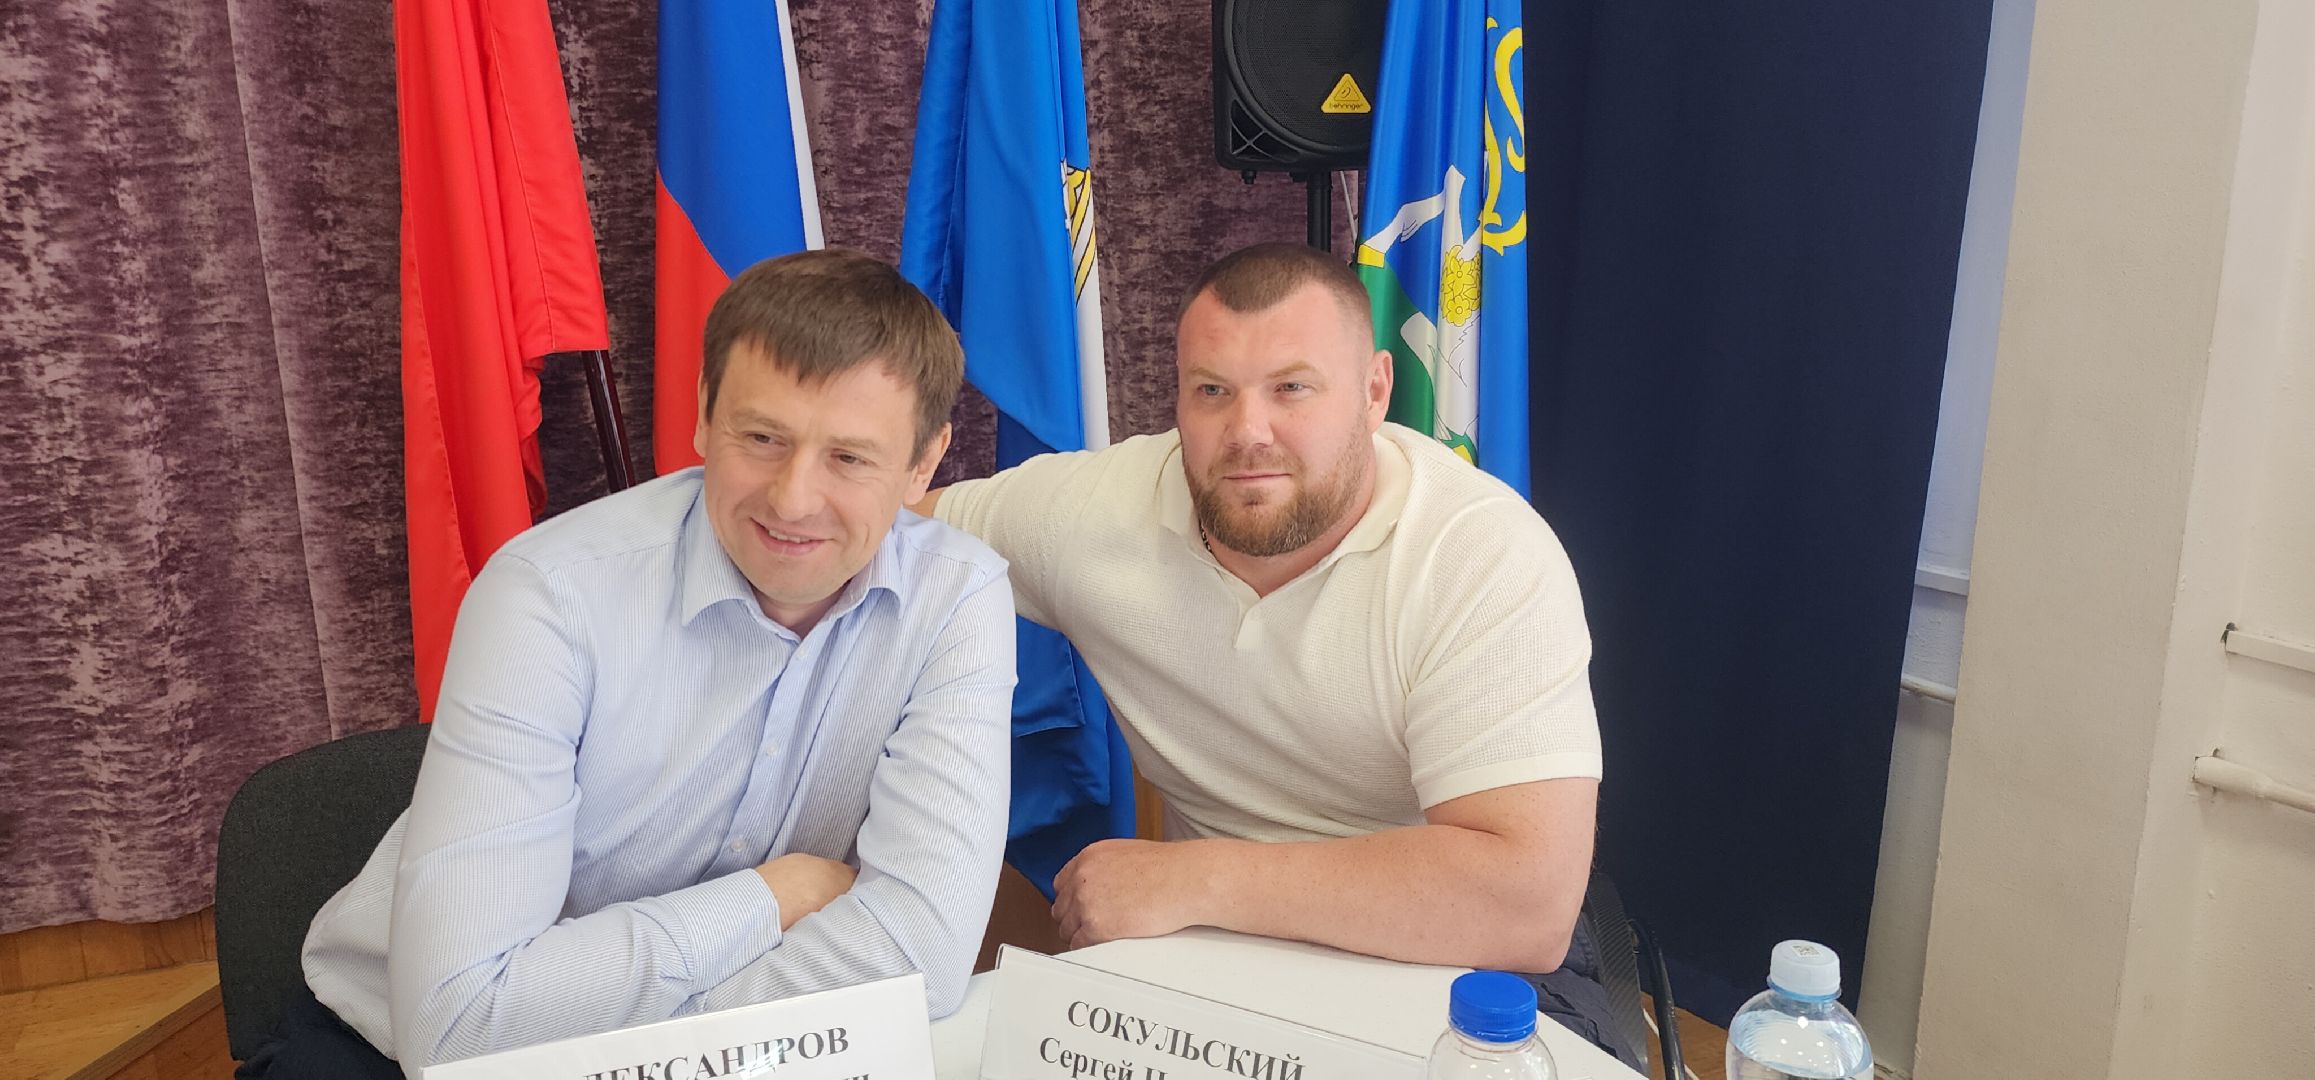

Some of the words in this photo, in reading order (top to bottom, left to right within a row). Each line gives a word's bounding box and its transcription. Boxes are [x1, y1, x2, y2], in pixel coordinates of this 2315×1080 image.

[583, 1027, 849, 1080] КСАНДРОВ
[1040, 1037, 1134, 1080] Сергей
[1067, 1001, 1306, 1080] СОКУЛЬСКИЙ
